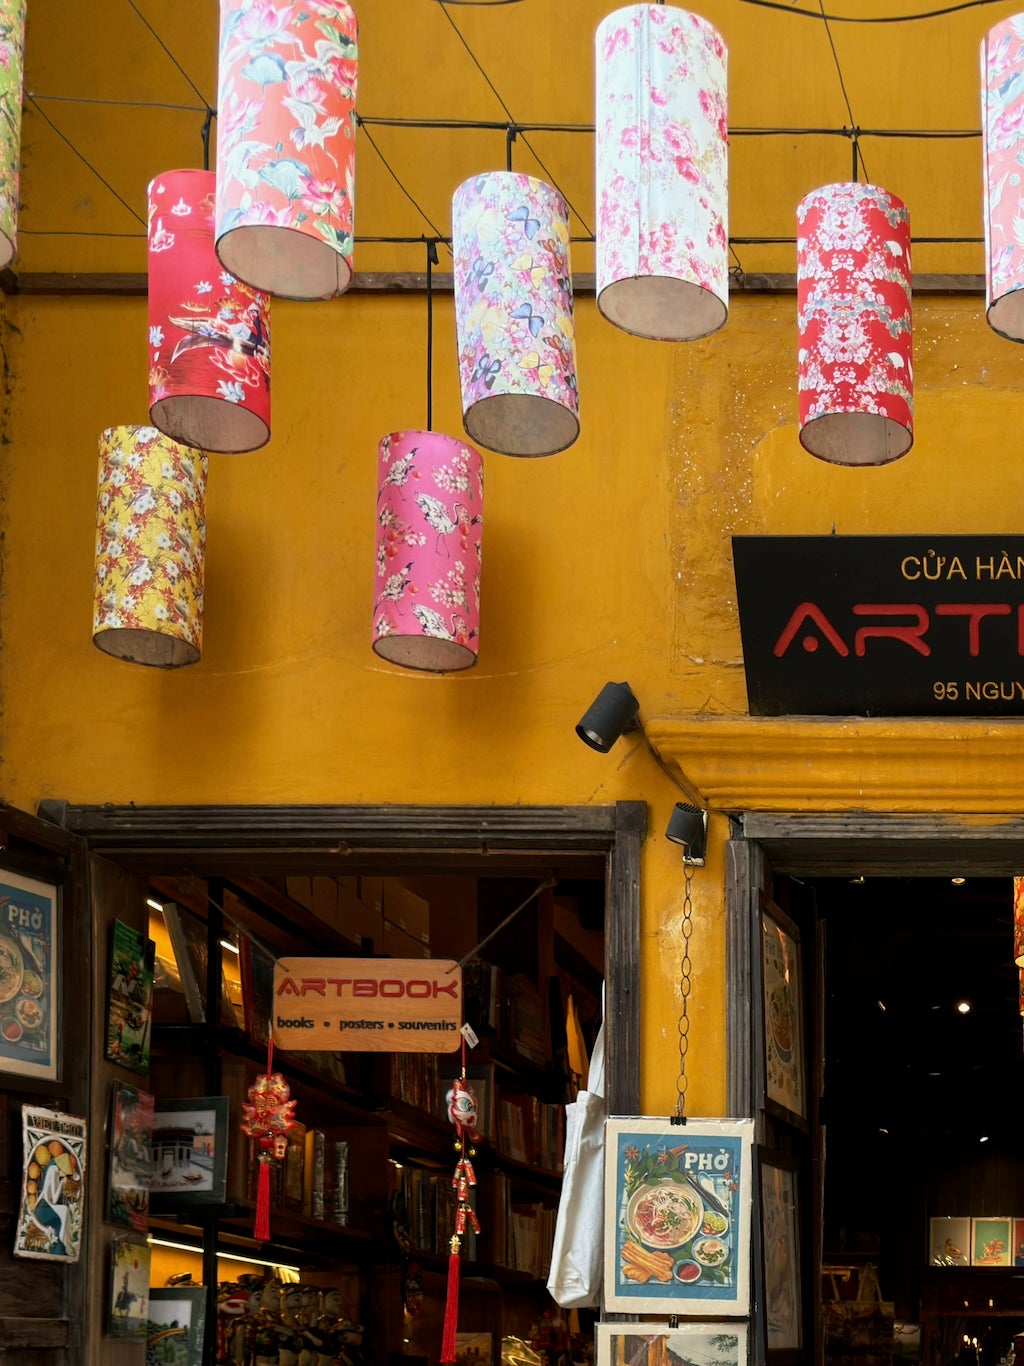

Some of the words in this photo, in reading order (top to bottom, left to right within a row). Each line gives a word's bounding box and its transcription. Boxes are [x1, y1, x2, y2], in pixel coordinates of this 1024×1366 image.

[900, 549, 968, 580] CỬA
[932, 681, 960, 701] 95
[8, 904, 43, 930] PHỞ
[276, 976, 459, 999] ARTBOOK
[276, 1016, 315, 1029] books
[339, 1018, 384, 1032] posters
[397, 1019, 457, 1032] souvenirs
[684, 1148, 730, 1171] PHỞ
